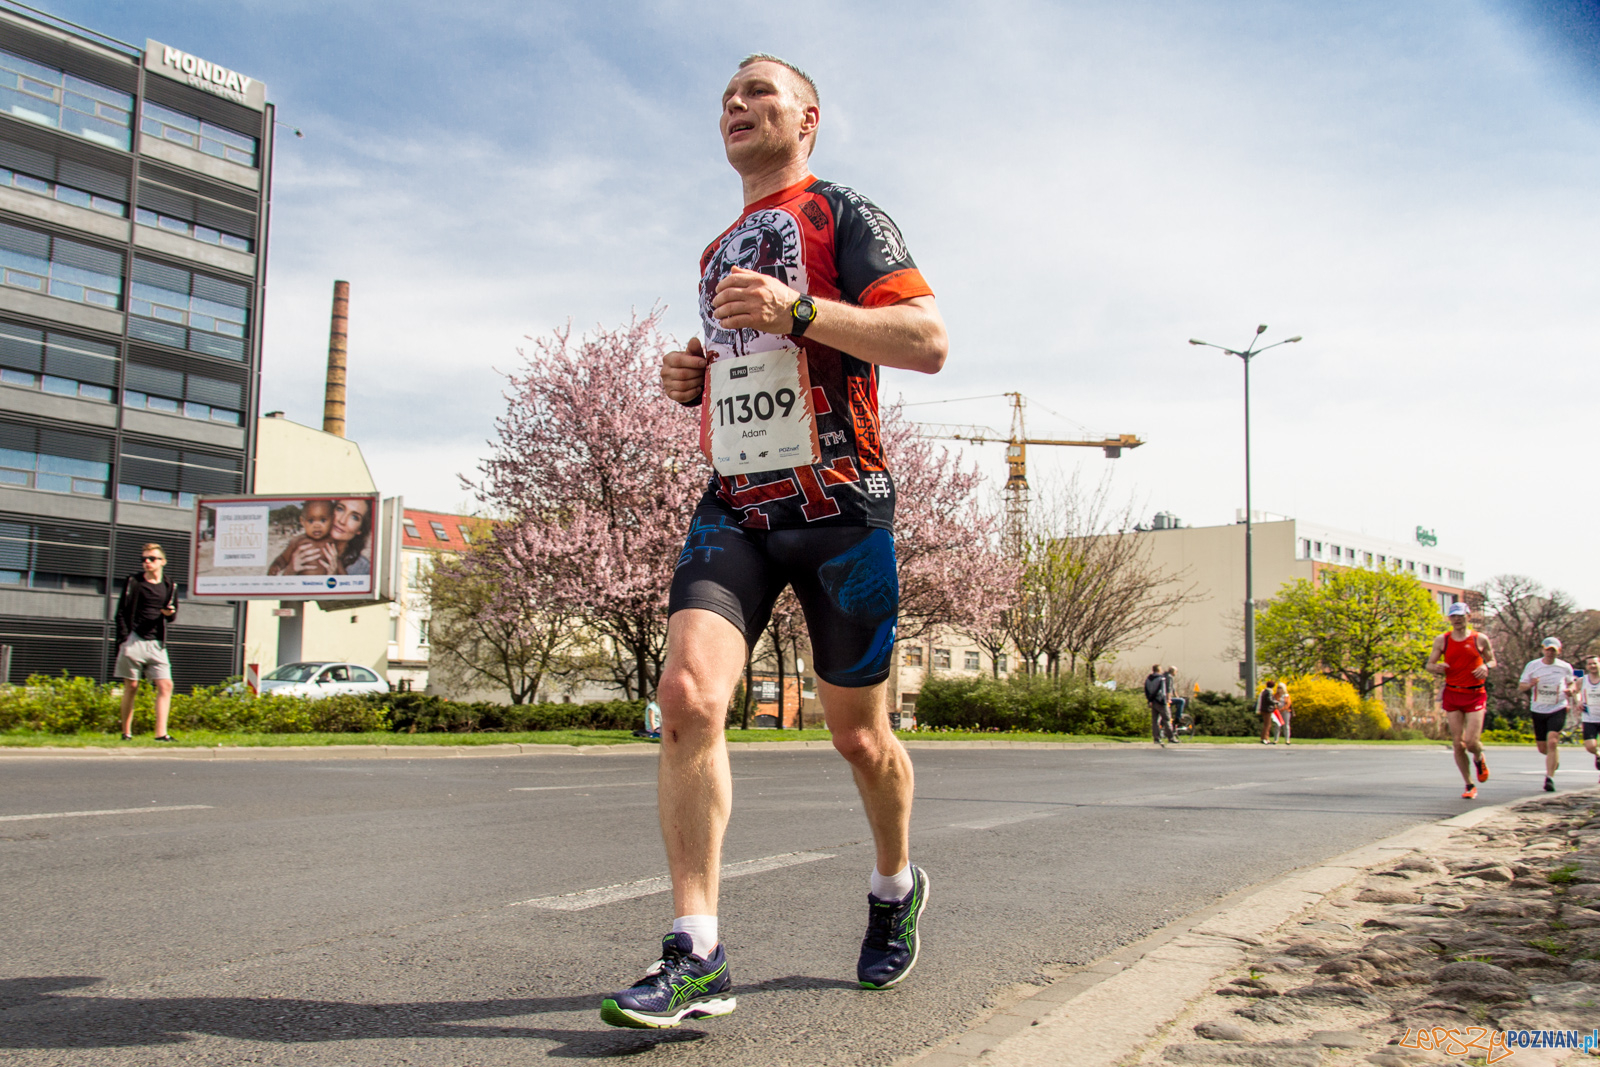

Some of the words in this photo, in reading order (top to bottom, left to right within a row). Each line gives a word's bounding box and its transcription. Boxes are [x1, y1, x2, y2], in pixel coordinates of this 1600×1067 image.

[163, 46, 252, 93] MONDAY
[858, 203, 886, 241] HOBBY
[716, 388, 796, 427] 11309
[741, 429, 767, 439] Adam
